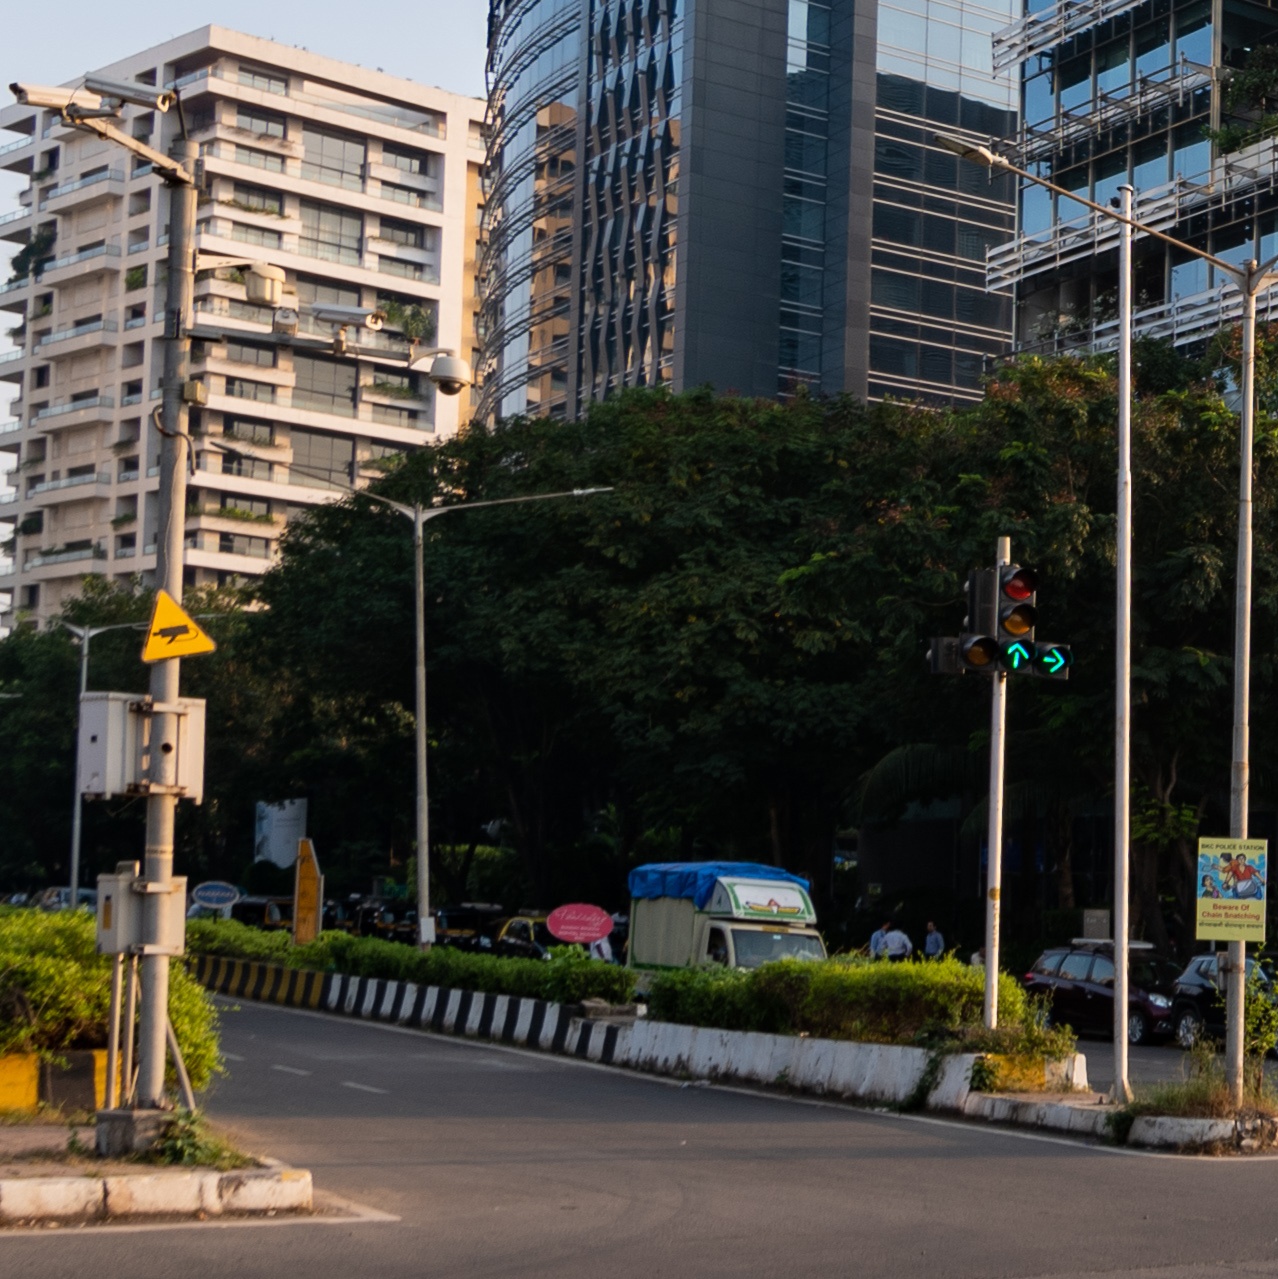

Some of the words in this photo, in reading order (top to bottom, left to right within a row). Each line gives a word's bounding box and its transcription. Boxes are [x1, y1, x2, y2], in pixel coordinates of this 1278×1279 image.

[1215, 843, 1237, 851] POLICE
[1212, 903, 1239, 911] Beware
[1201, 911, 1223, 919] Chain
[1223, 912, 1261, 921] Snatching
